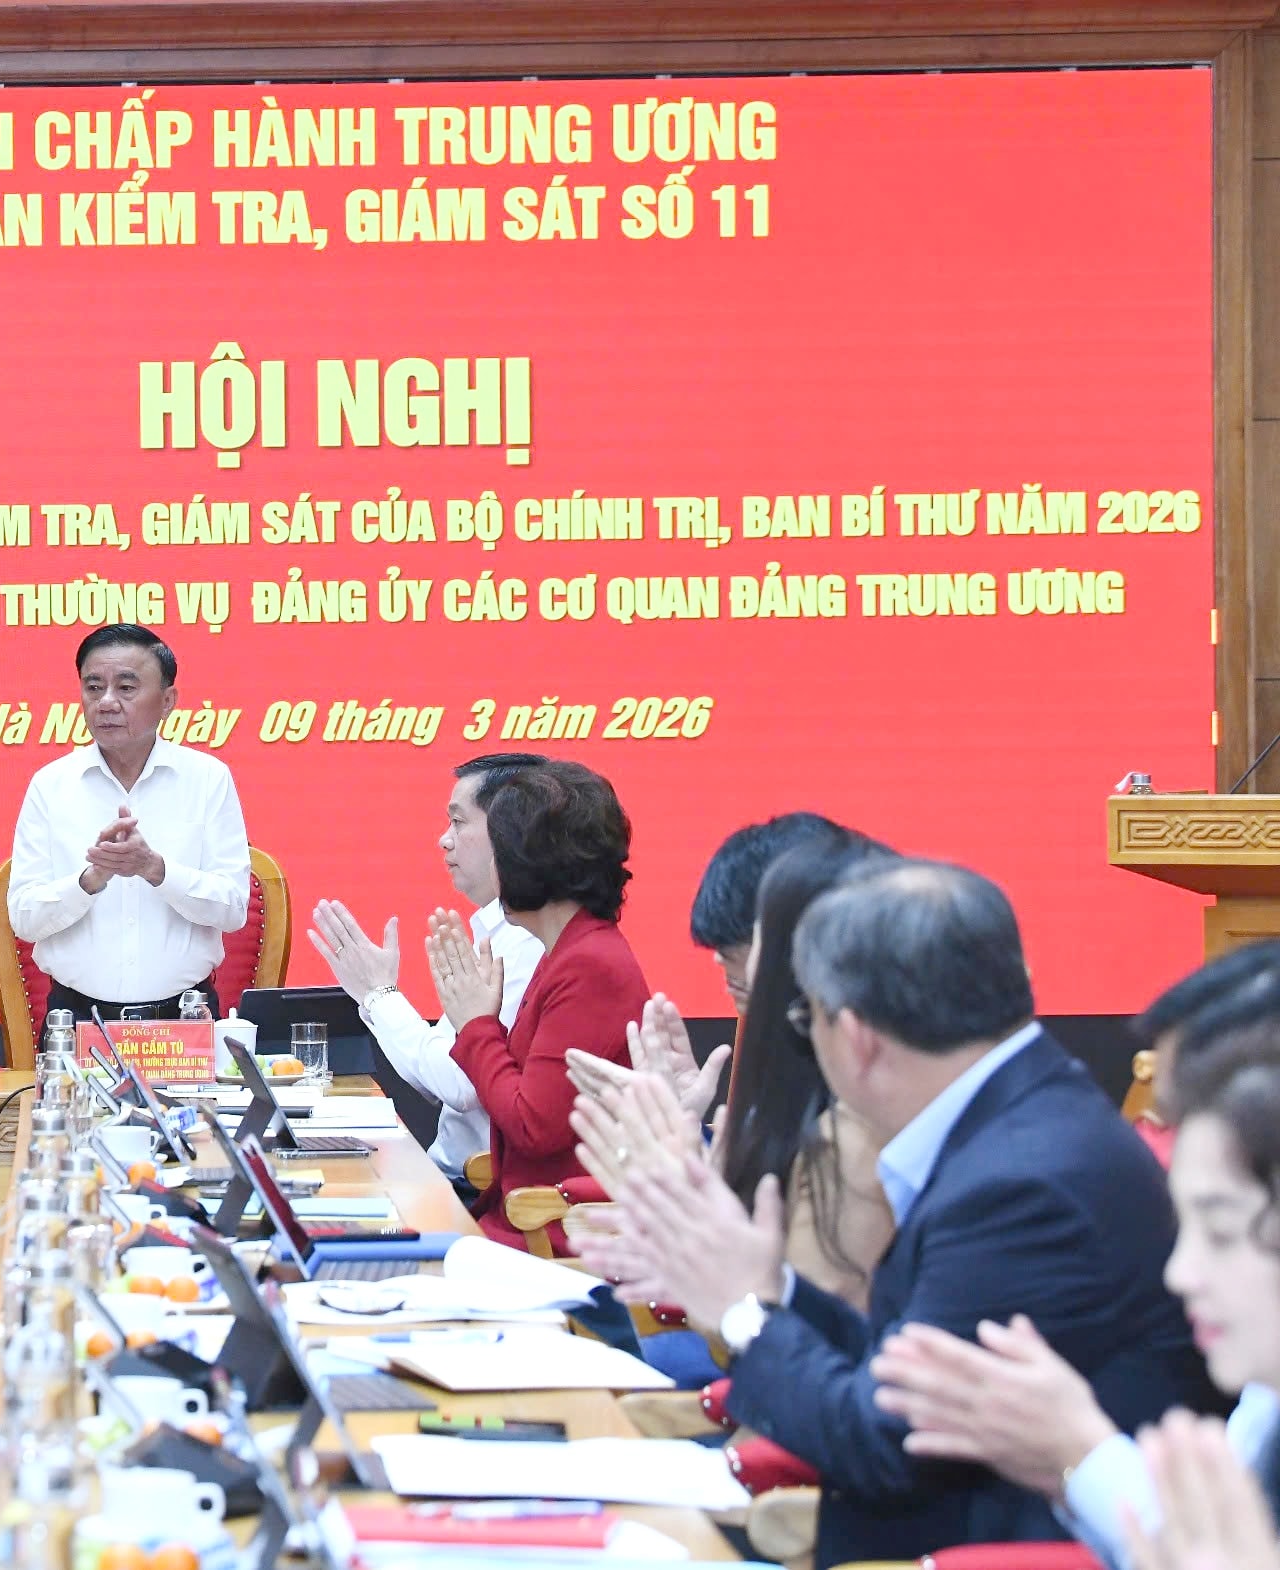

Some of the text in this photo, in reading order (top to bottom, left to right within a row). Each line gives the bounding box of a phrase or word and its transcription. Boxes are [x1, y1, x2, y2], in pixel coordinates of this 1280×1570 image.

[35, 89, 192, 171] CHẤP
[214, 96, 375, 168] HÀNH
[395, 103, 591, 165] TRUNG
[613, 97, 776, 163] ƯƠNG
[60, 170, 196, 247] KIỂM
[212, 191, 327, 251] TRA,
[346, 175, 485, 244] GIÁM
[503, 175, 606, 242] SÁT
[621, 165, 695, 240] SỐ
[712, 184, 769, 238] 11
[139, 342, 531, 469] HỘI NGHỊ
[41, 504, 130, 550] TRA,
[142, 494, 249, 546] GIÁM
[262, 493, 340, 544] SÁT
[352, 487, 436, 543] CỦA
[447, 491, 502, 551] BỘ
[515, 490, 642, 542] CHÍNH
[653, 497, 731, 549] TRỊ,
[743, 495, 830, 538] BAN
[842, 486, 884, 537] BÍ
[894, 489, 980, 536] THƯ
[987, 484, 1086, 535] NĂM
[1097, 490, 1200, 534] 2026
[0, 573, 164, 626] THƯỜNG
[175, 582, 229, 634] VỤ
[251, 567, 366, 624] ĐẢNG
[379, 566, 432, 623] ỦY
[444, 571, 527, 622] CÁC
[539, 574, 596, 621] CƠ
[607, 577, 719, 625] QUAN
[729, 562, 846, 618] ĐẢNG
[856, 573, 996, 617] TRUNG
[1008, 568, 1124, 615] ƯƠNG
[156, 701, 241, 748] gày
[260, 700, 318, 743] 09
[322, 699, 445, 746] tháng
[463, 698, 496, 741] 3
[500, 696, 596, 740] năm
[603, 695, 714, 739] 2026
[111, 1037, 184, 1055] RẦN CẨM TÚ
